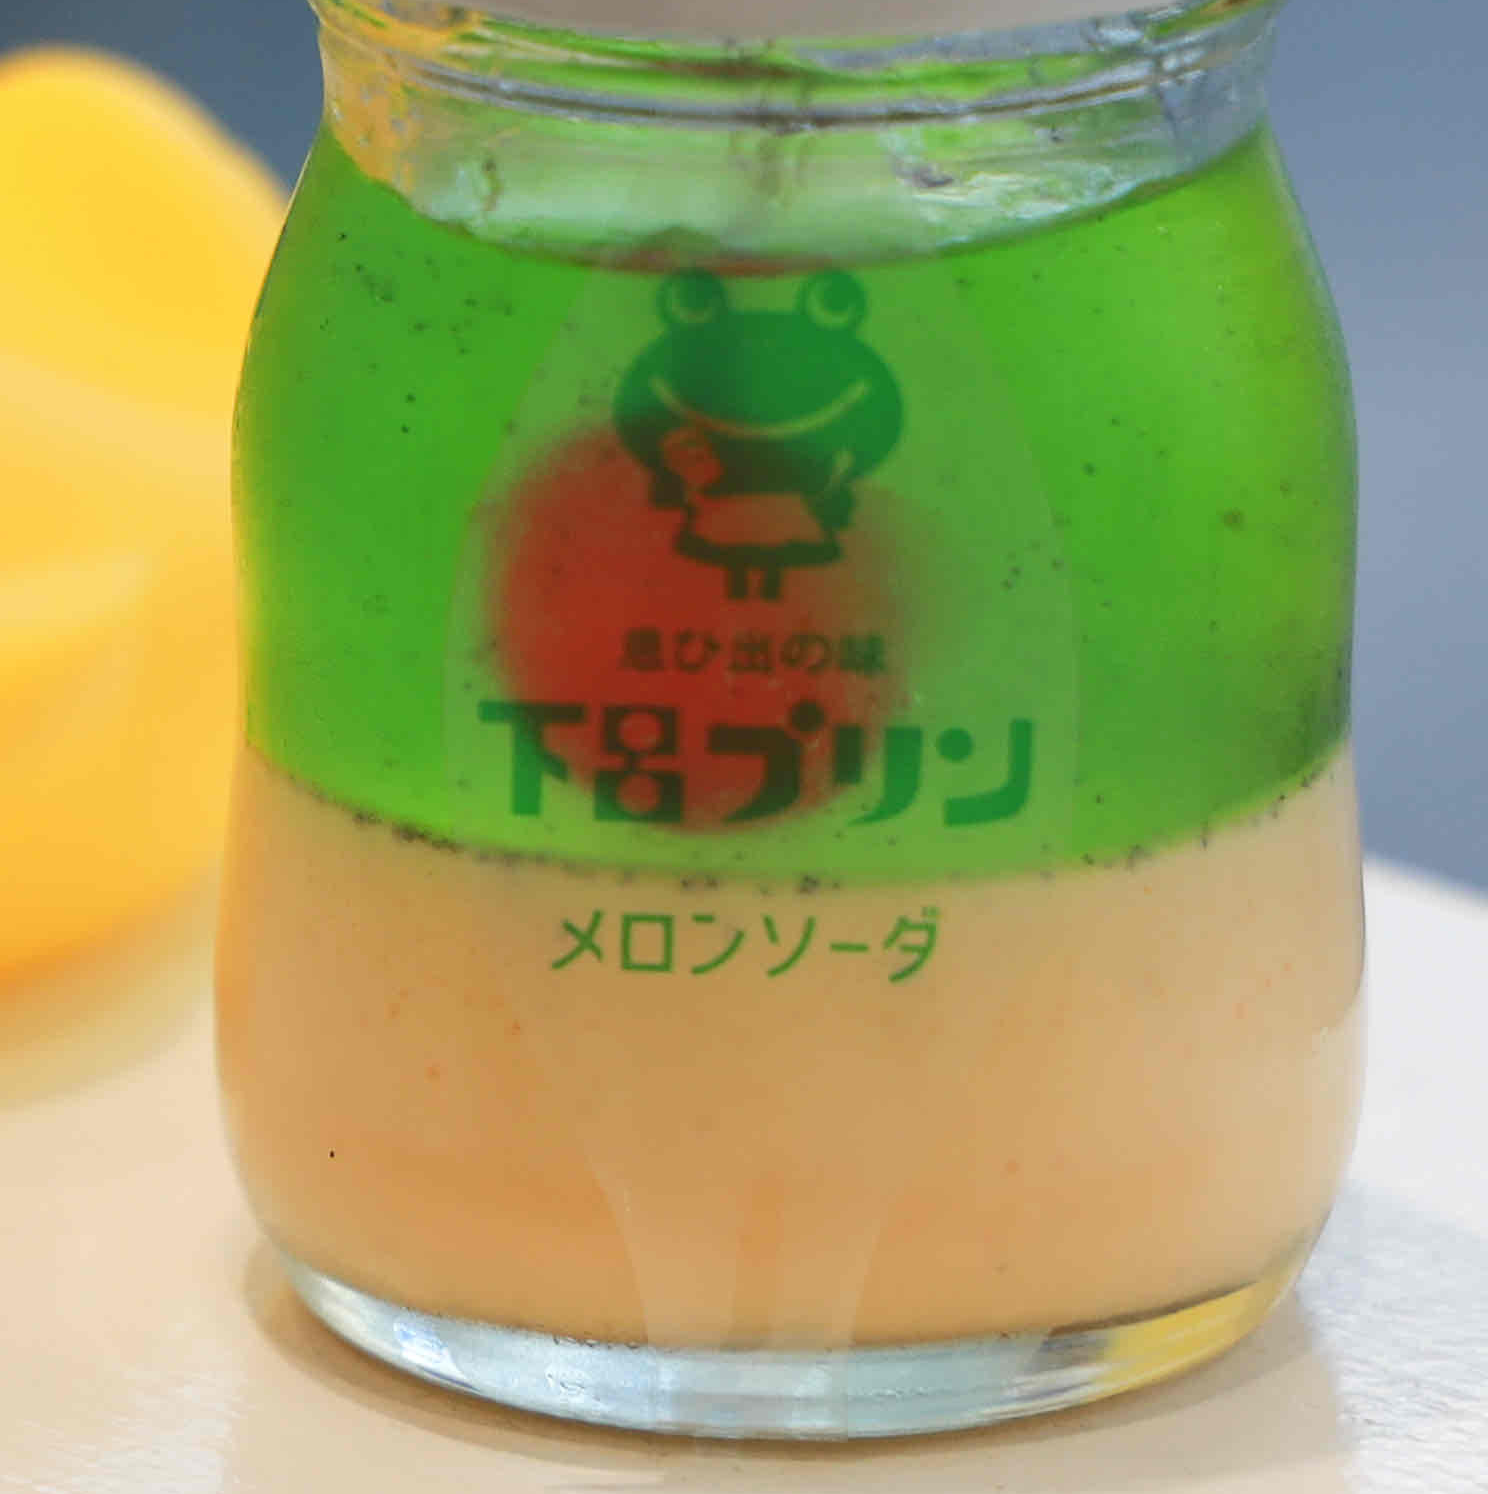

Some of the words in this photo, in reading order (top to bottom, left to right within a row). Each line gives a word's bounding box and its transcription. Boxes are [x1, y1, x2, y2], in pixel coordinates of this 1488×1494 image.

[478, 700, 1033, 827] 下呂プリン
[550, 907, 941, 983] メロンソーダ
